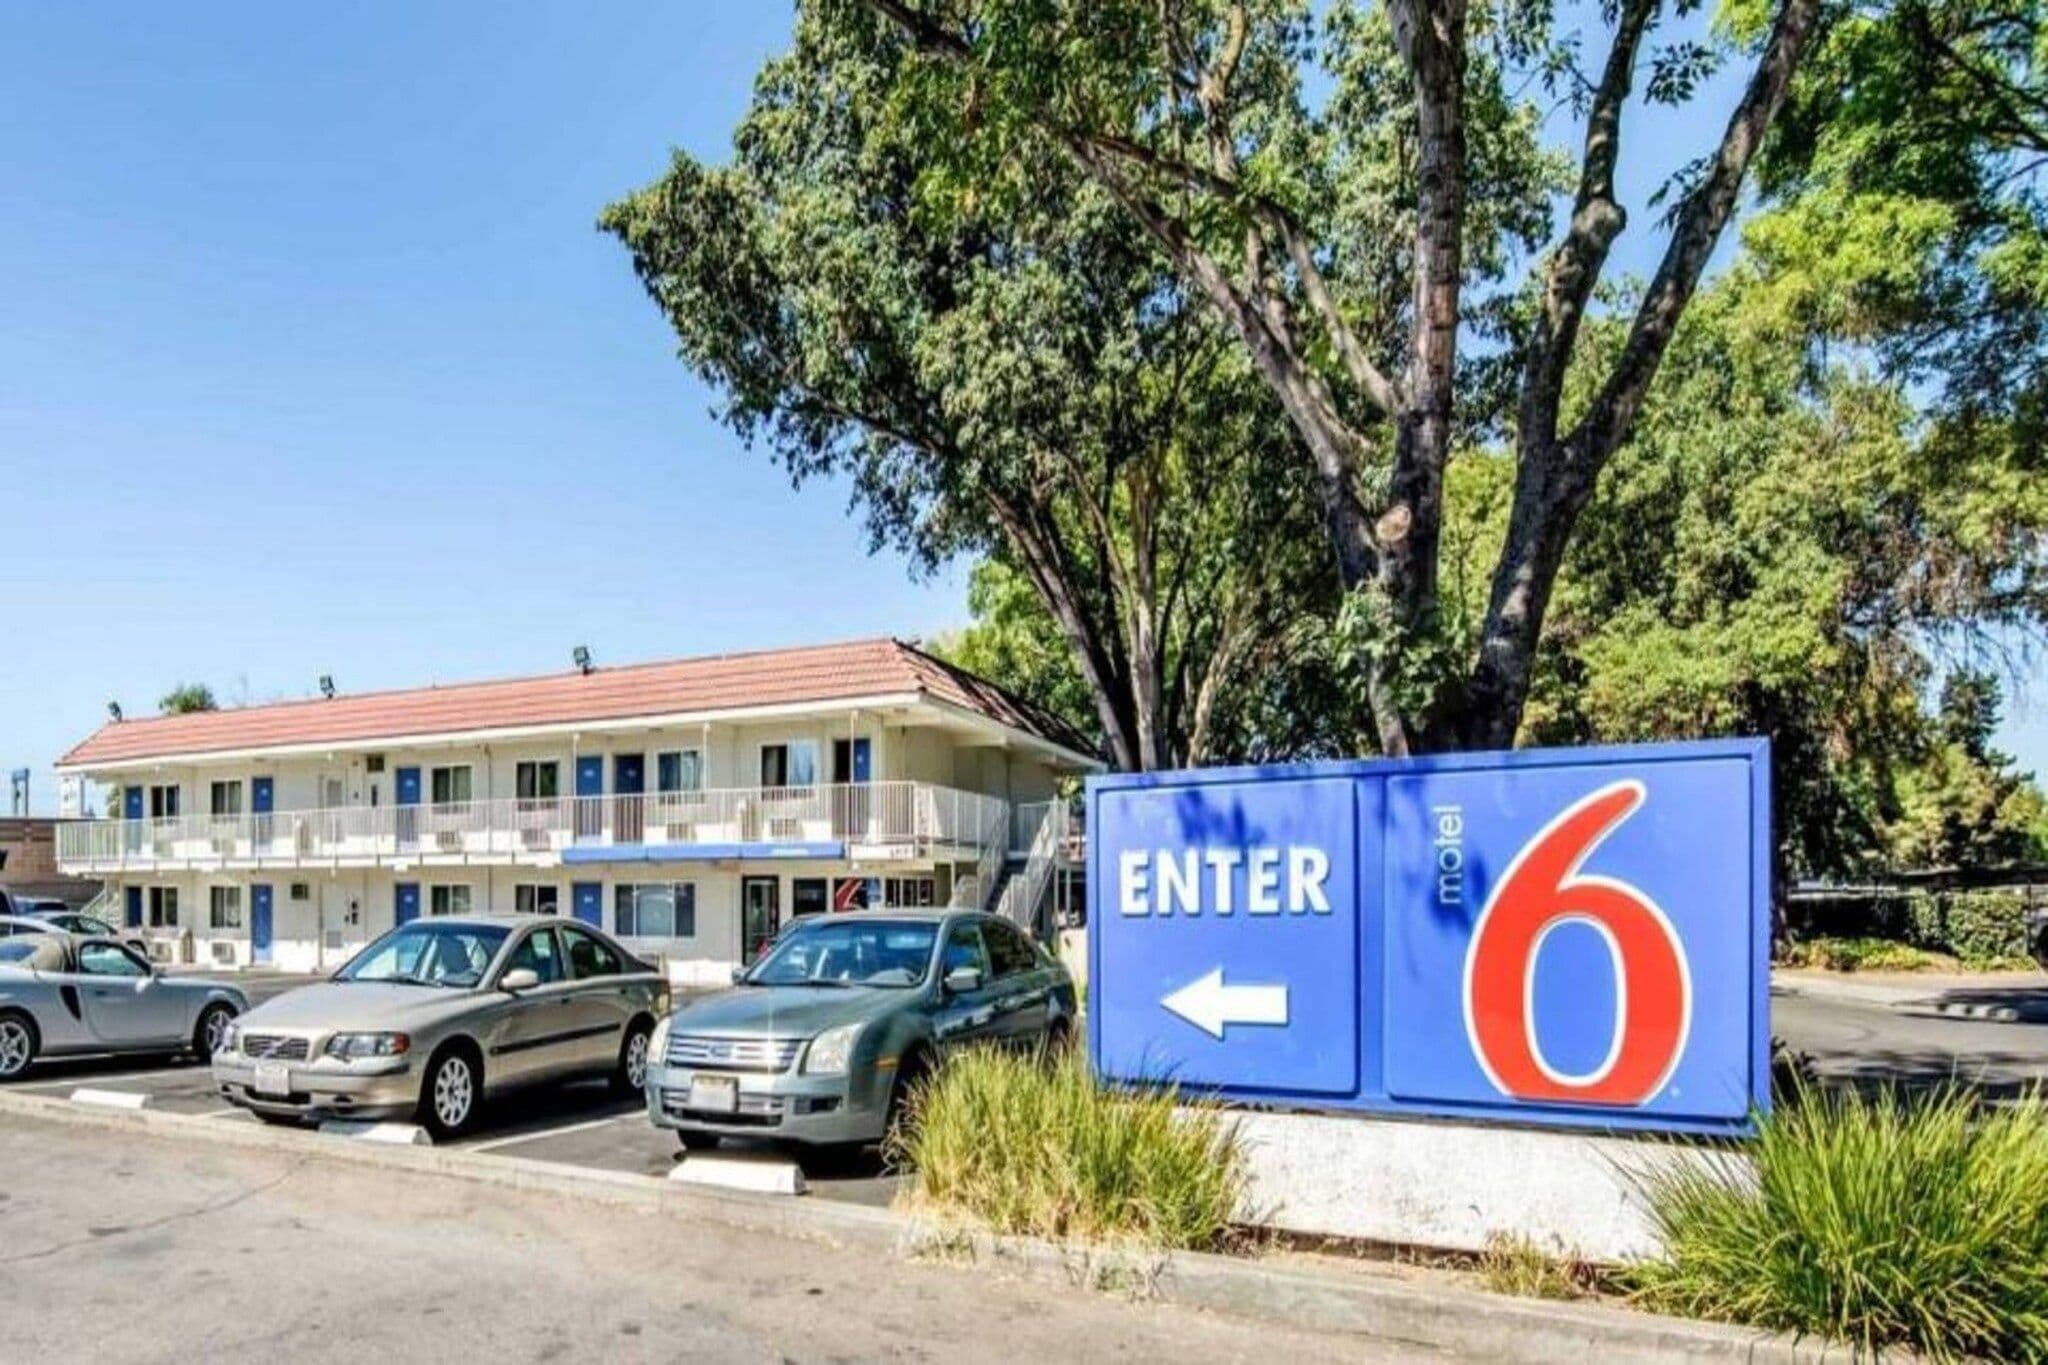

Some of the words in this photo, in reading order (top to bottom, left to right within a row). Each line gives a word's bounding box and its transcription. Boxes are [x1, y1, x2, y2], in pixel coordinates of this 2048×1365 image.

[1119, 847, 1332, 916] ENTER
[1433, 805, 1462, 904] motel
[1464, 779, 1692, 1107] 6
